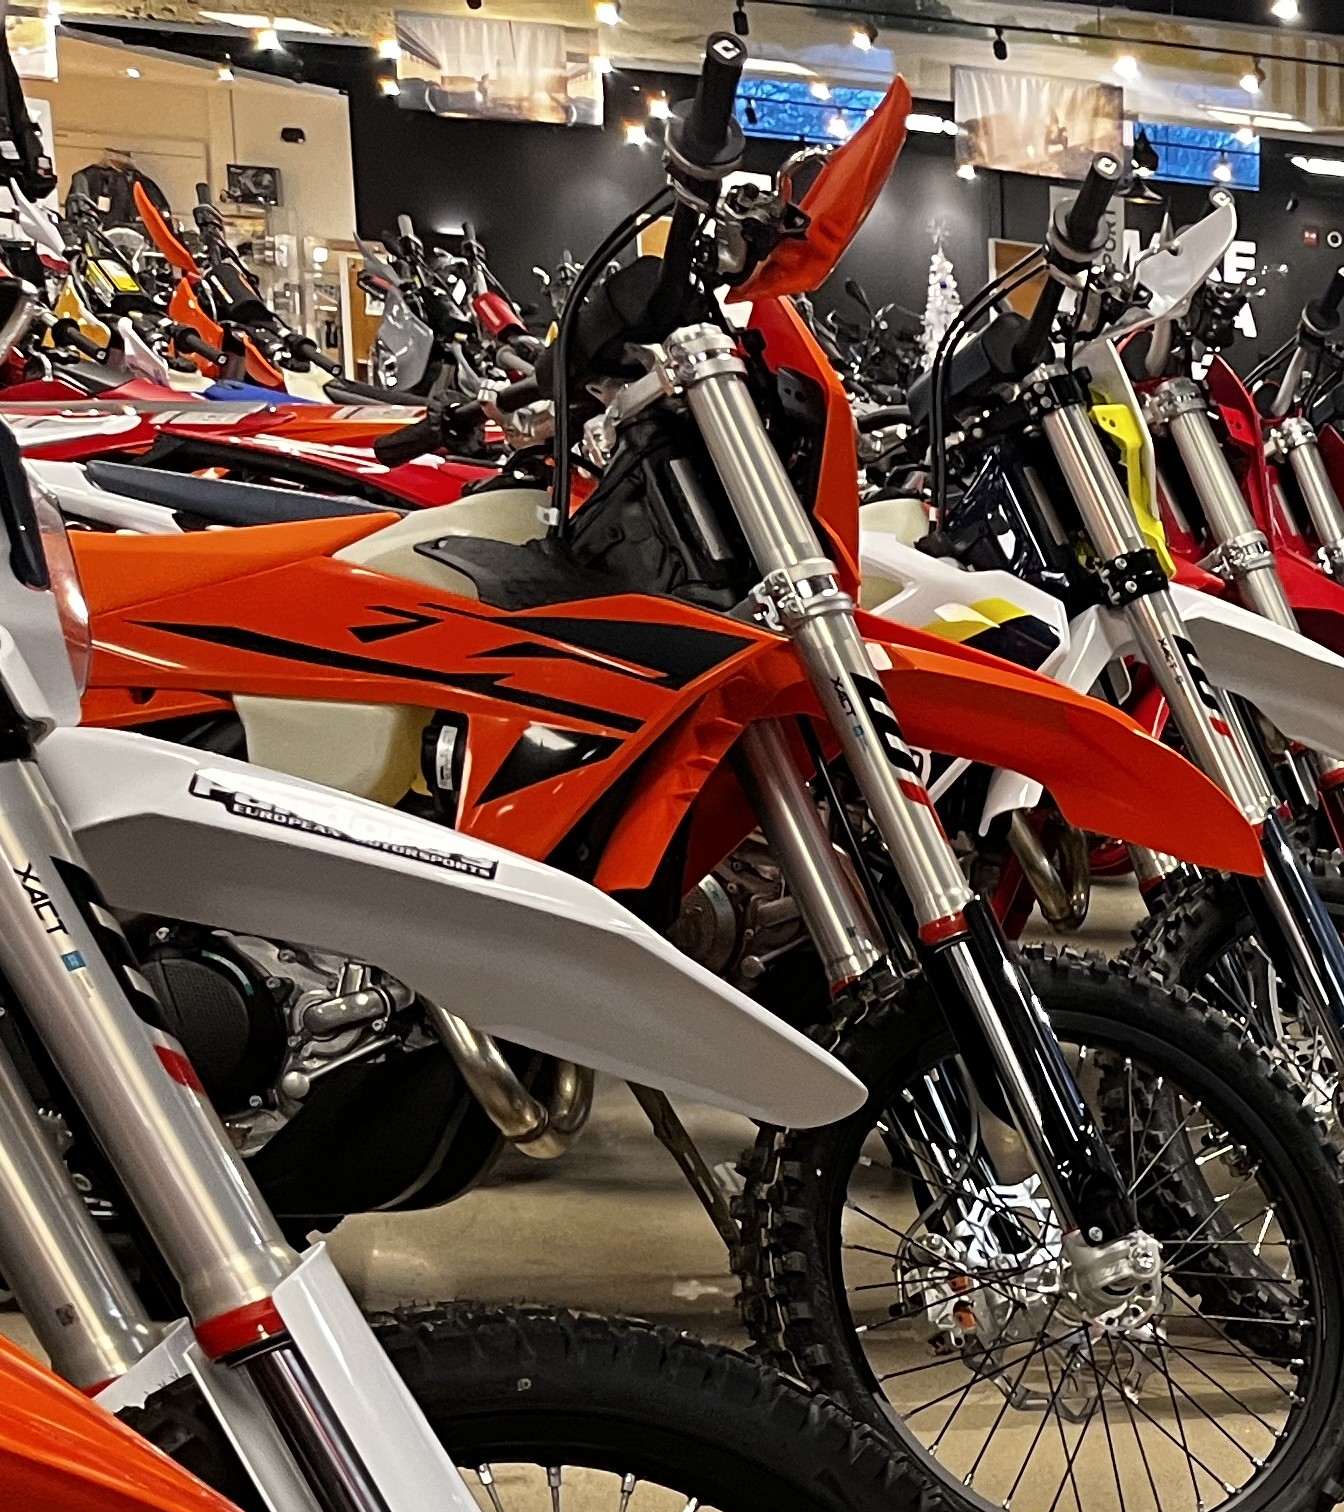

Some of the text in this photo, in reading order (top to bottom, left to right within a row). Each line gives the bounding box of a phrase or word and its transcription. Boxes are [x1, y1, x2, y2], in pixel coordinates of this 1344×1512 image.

[233, 803, 492, 878] EUROPEAN OTORSPORTS
[13, 862, 70, 936] XACT
